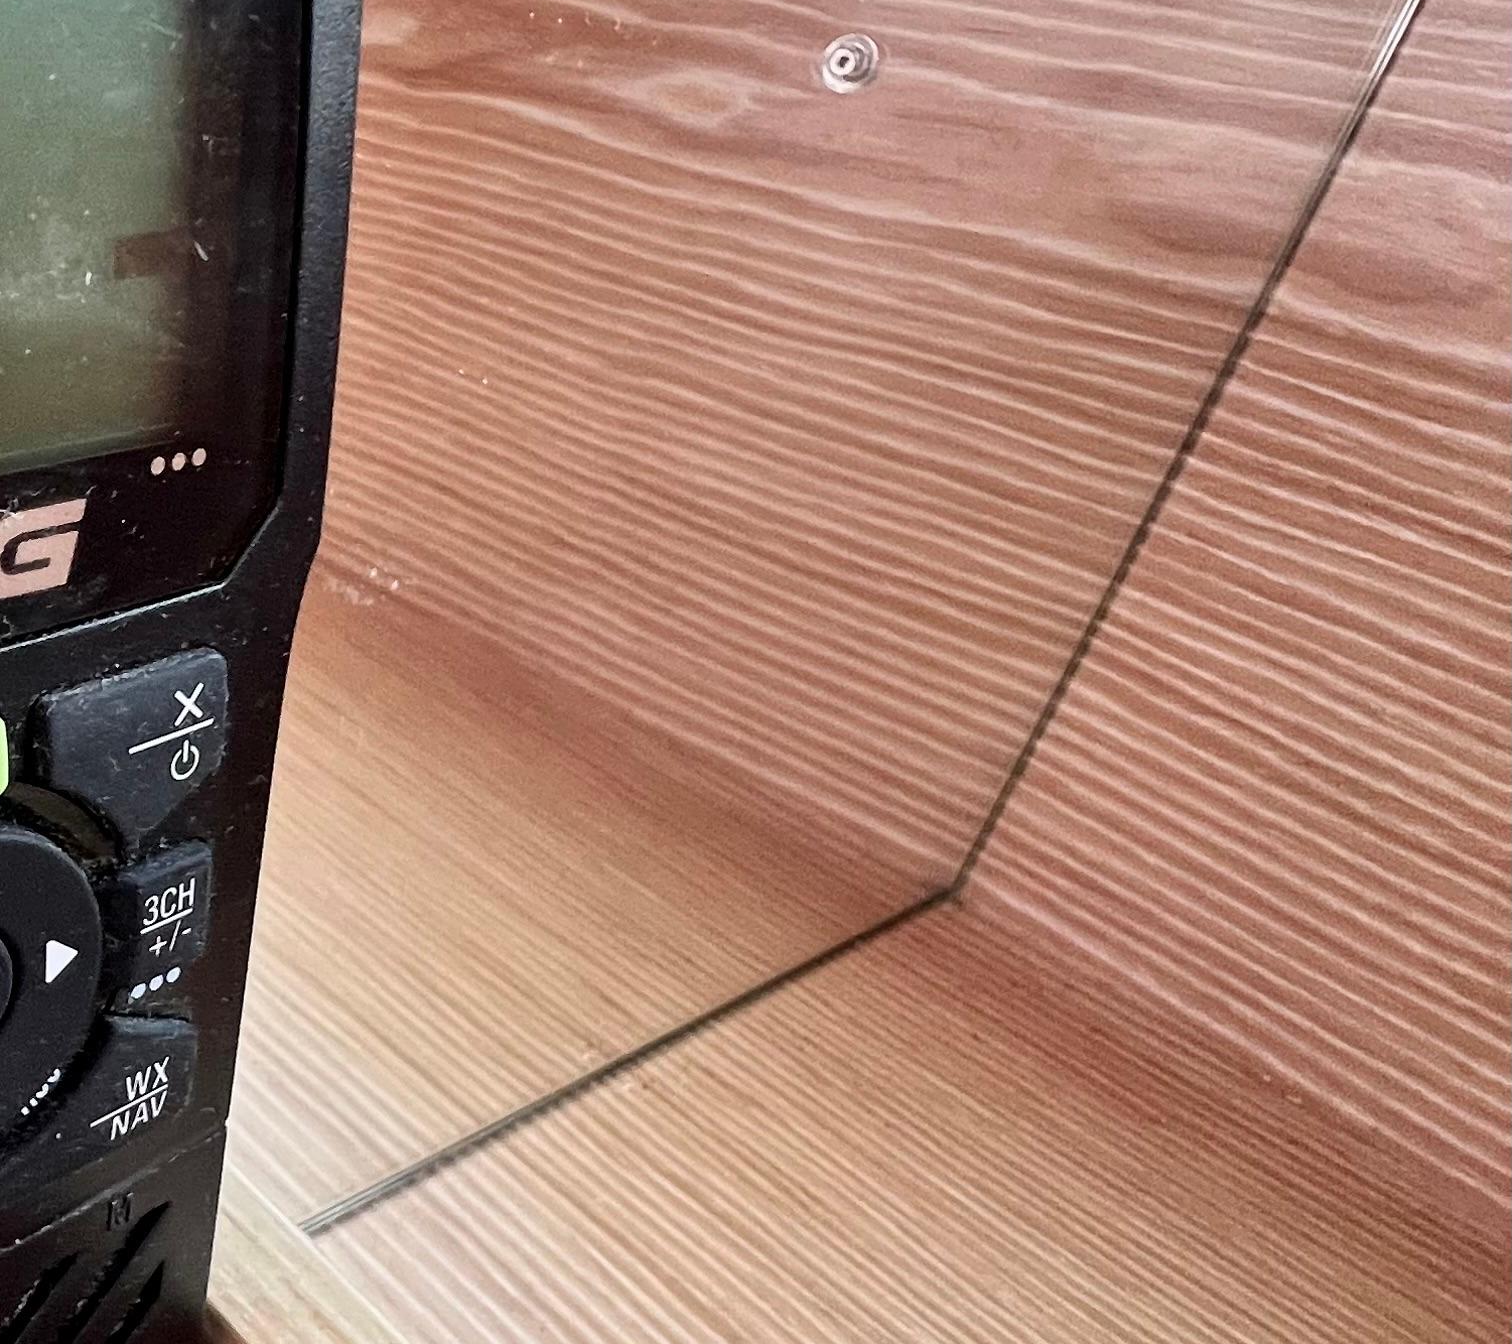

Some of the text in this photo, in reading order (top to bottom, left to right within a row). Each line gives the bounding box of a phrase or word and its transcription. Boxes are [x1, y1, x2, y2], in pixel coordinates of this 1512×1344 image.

[142, 877, 196, 927] 3CH
[125, 1055, 170, 1101] WX
[109, 1089, 168, 1141] NAV
